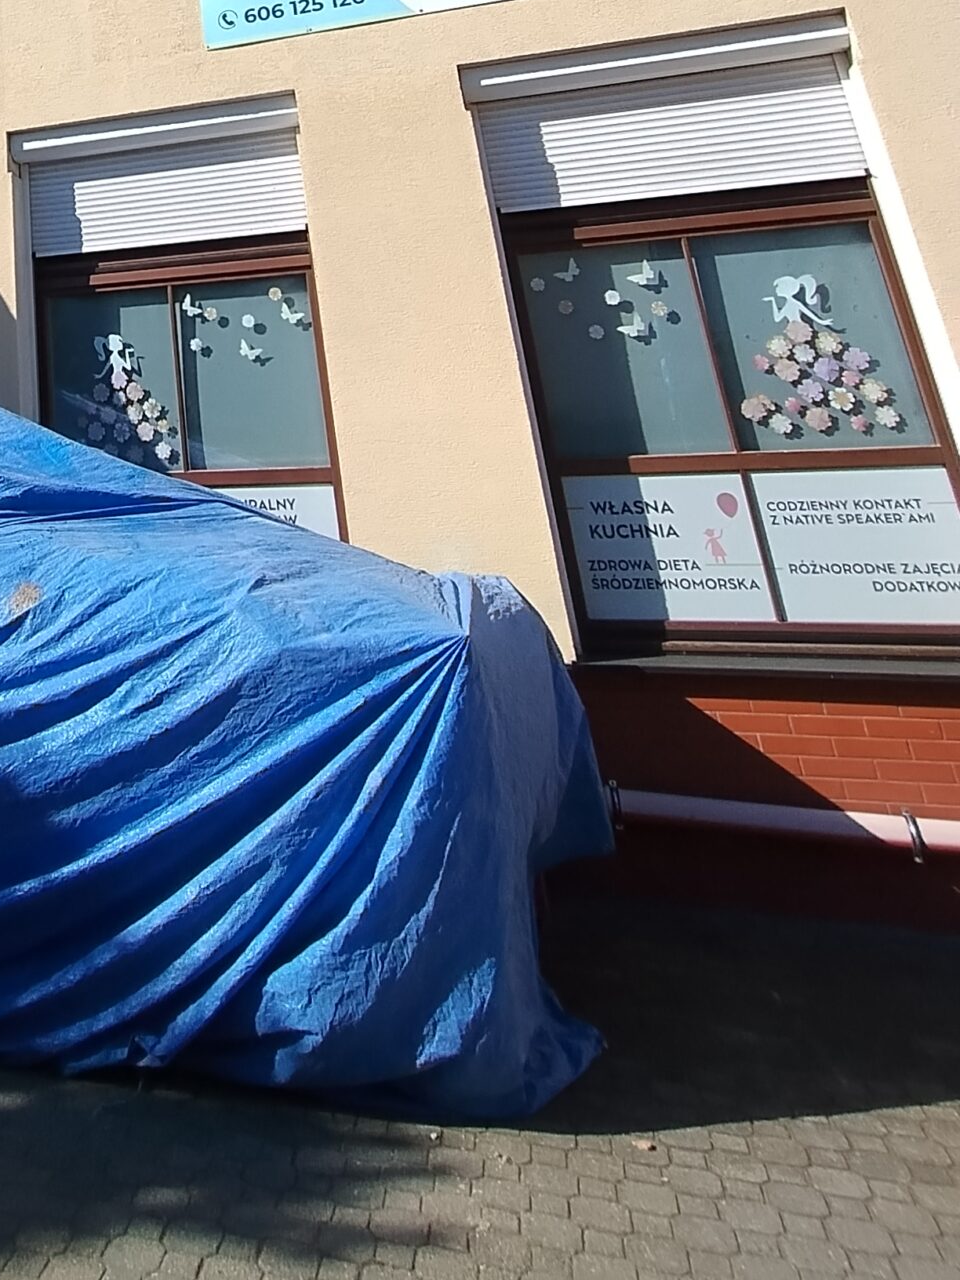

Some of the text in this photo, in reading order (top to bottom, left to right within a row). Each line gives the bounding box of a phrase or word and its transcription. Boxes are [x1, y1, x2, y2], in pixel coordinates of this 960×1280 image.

[243, 2, 285, 24] 606
[589, 500, 675, 515] WŁASNA
[766, 498, 922, 512] CODZIENNY KONTAKT
[770, 514, 780, 526] Z
[783, 513, 834, 526] NATIVE
[588, 523, 680, 539] KUCHNIA
[587, 559, 702, 572] ZDROWA DIETA
[788, 560, 897, 575] RÓŻNORODNE
[591, 574, 761, 591] ŚRÓDZIEMNOMORSKA
